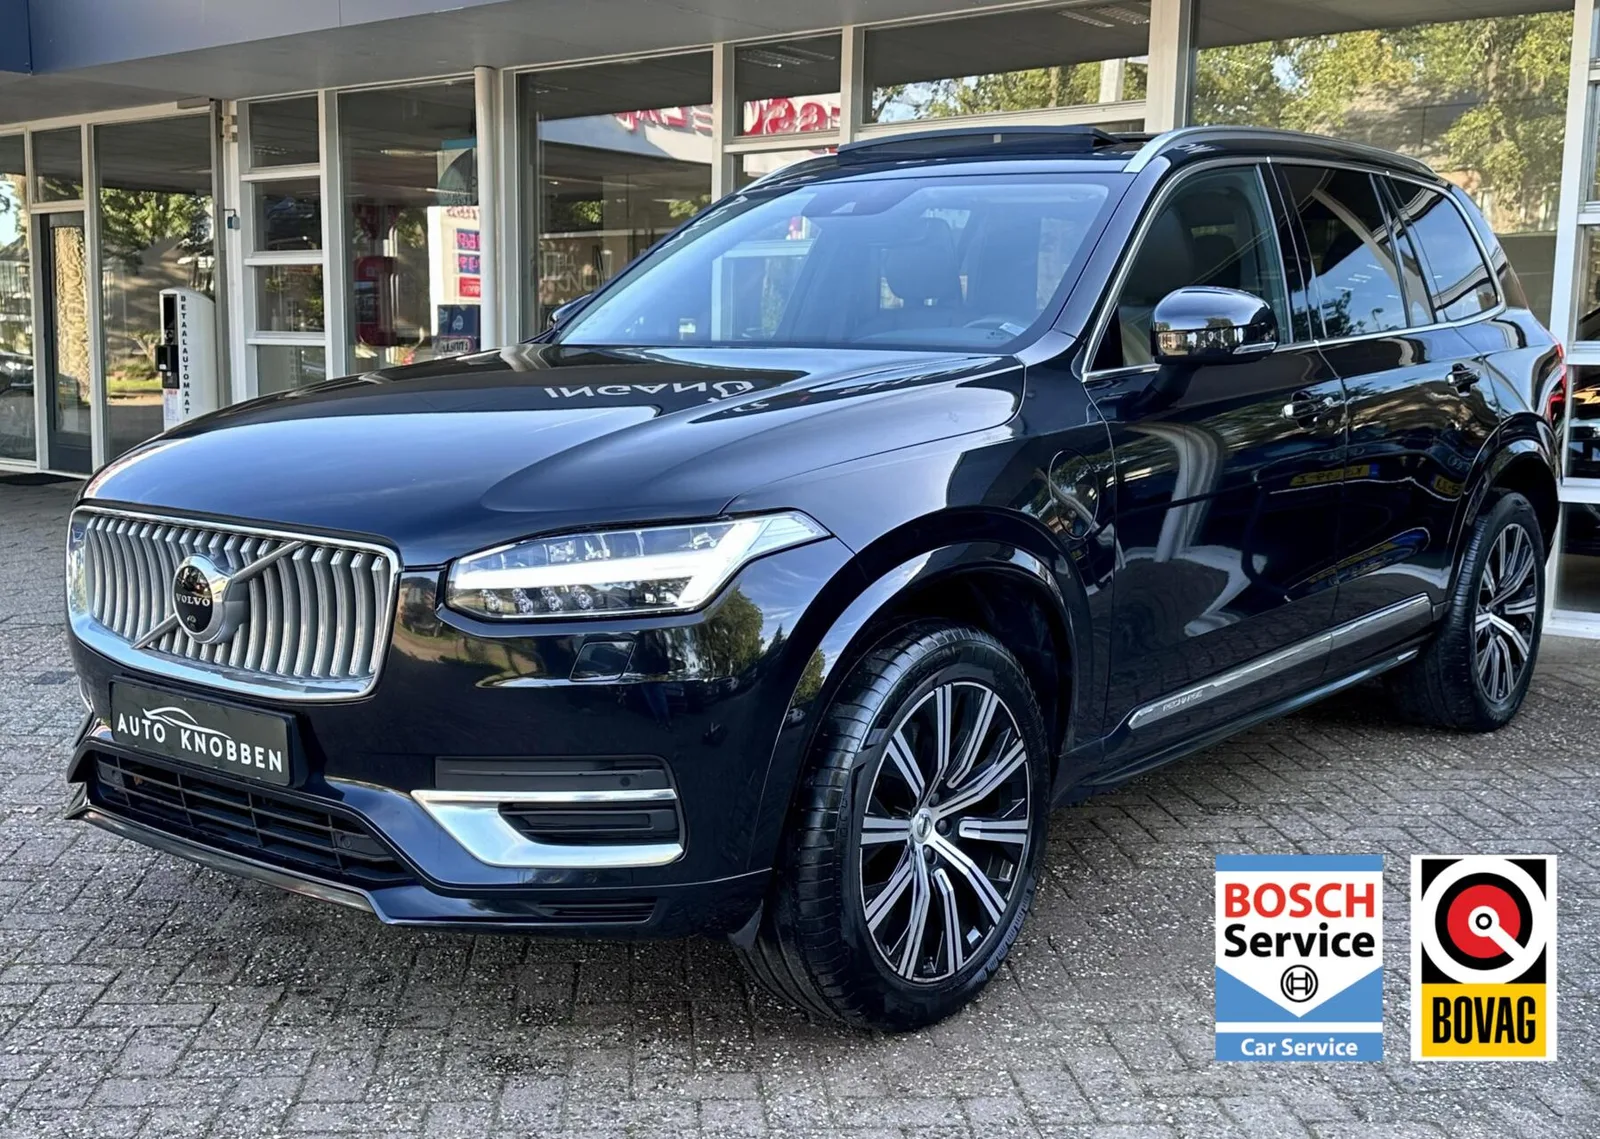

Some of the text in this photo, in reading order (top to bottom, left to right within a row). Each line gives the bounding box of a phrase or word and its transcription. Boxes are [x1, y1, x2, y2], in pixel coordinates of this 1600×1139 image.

[180, 295, 191, 414] BETAALAUTOMAAT
[175, 592, 211, 607] VOLVO
[117, 713, 283, 772] AUTO KNOBBEN
